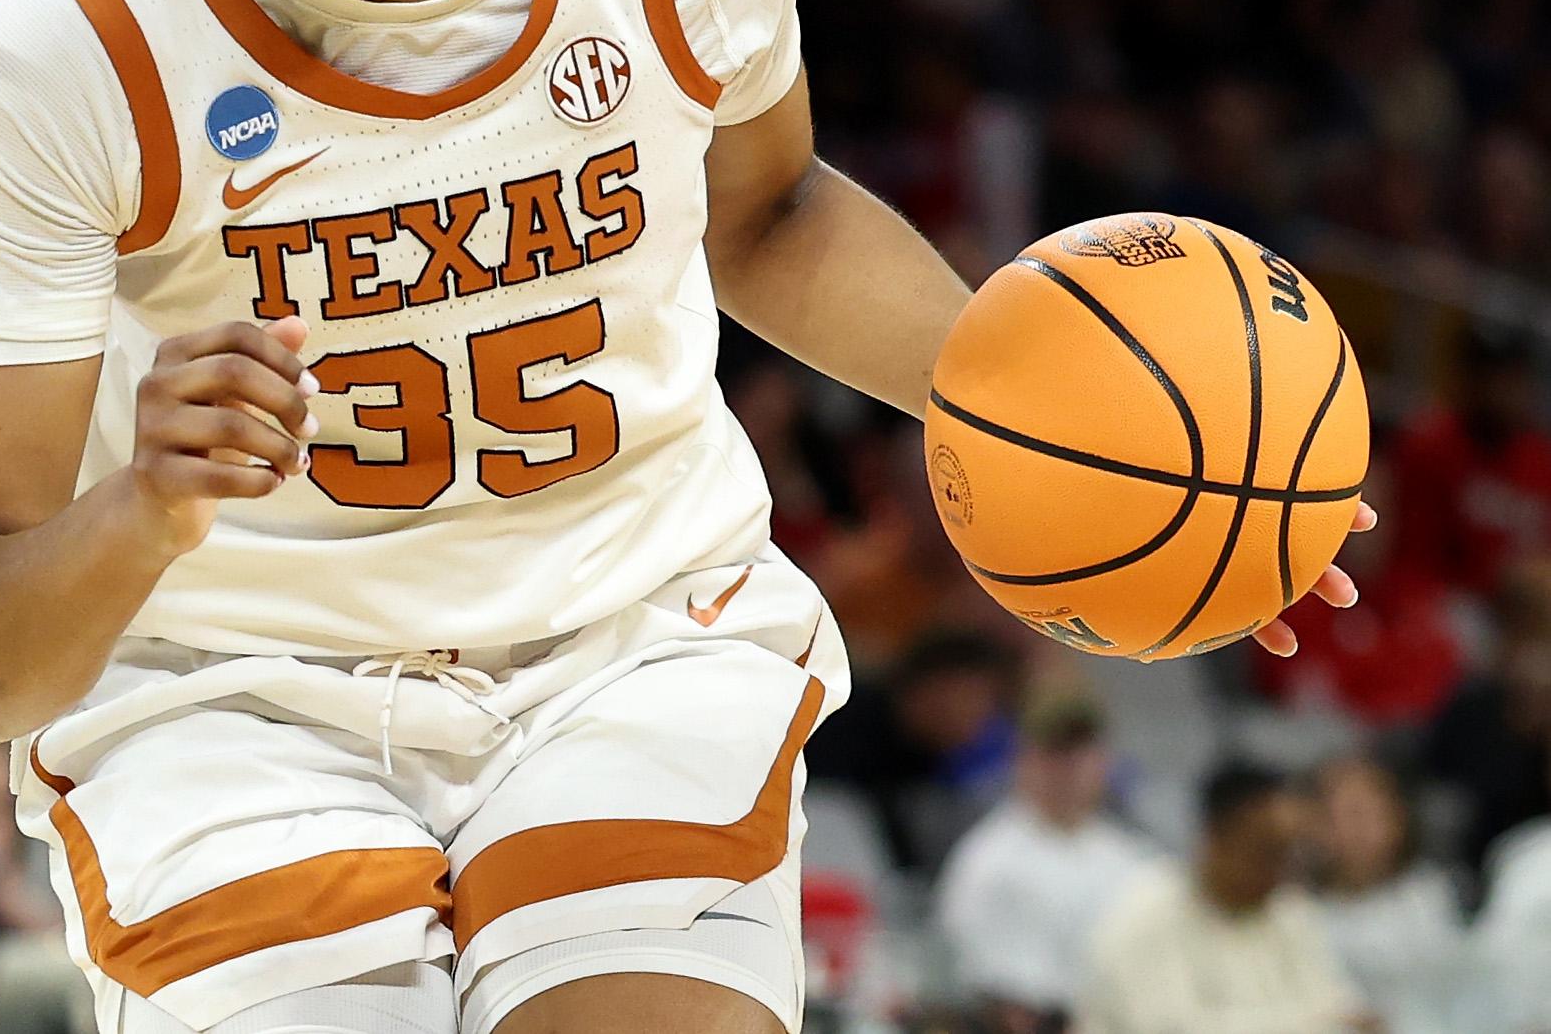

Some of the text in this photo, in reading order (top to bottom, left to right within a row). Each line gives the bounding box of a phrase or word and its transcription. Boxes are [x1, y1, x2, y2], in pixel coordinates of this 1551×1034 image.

[218, 111, 277, 150] NCAA
[552, 39, 628, 121] SEC
[222, 140, 646, 321] TEXAS
[306, 298, 619, 510] 35
